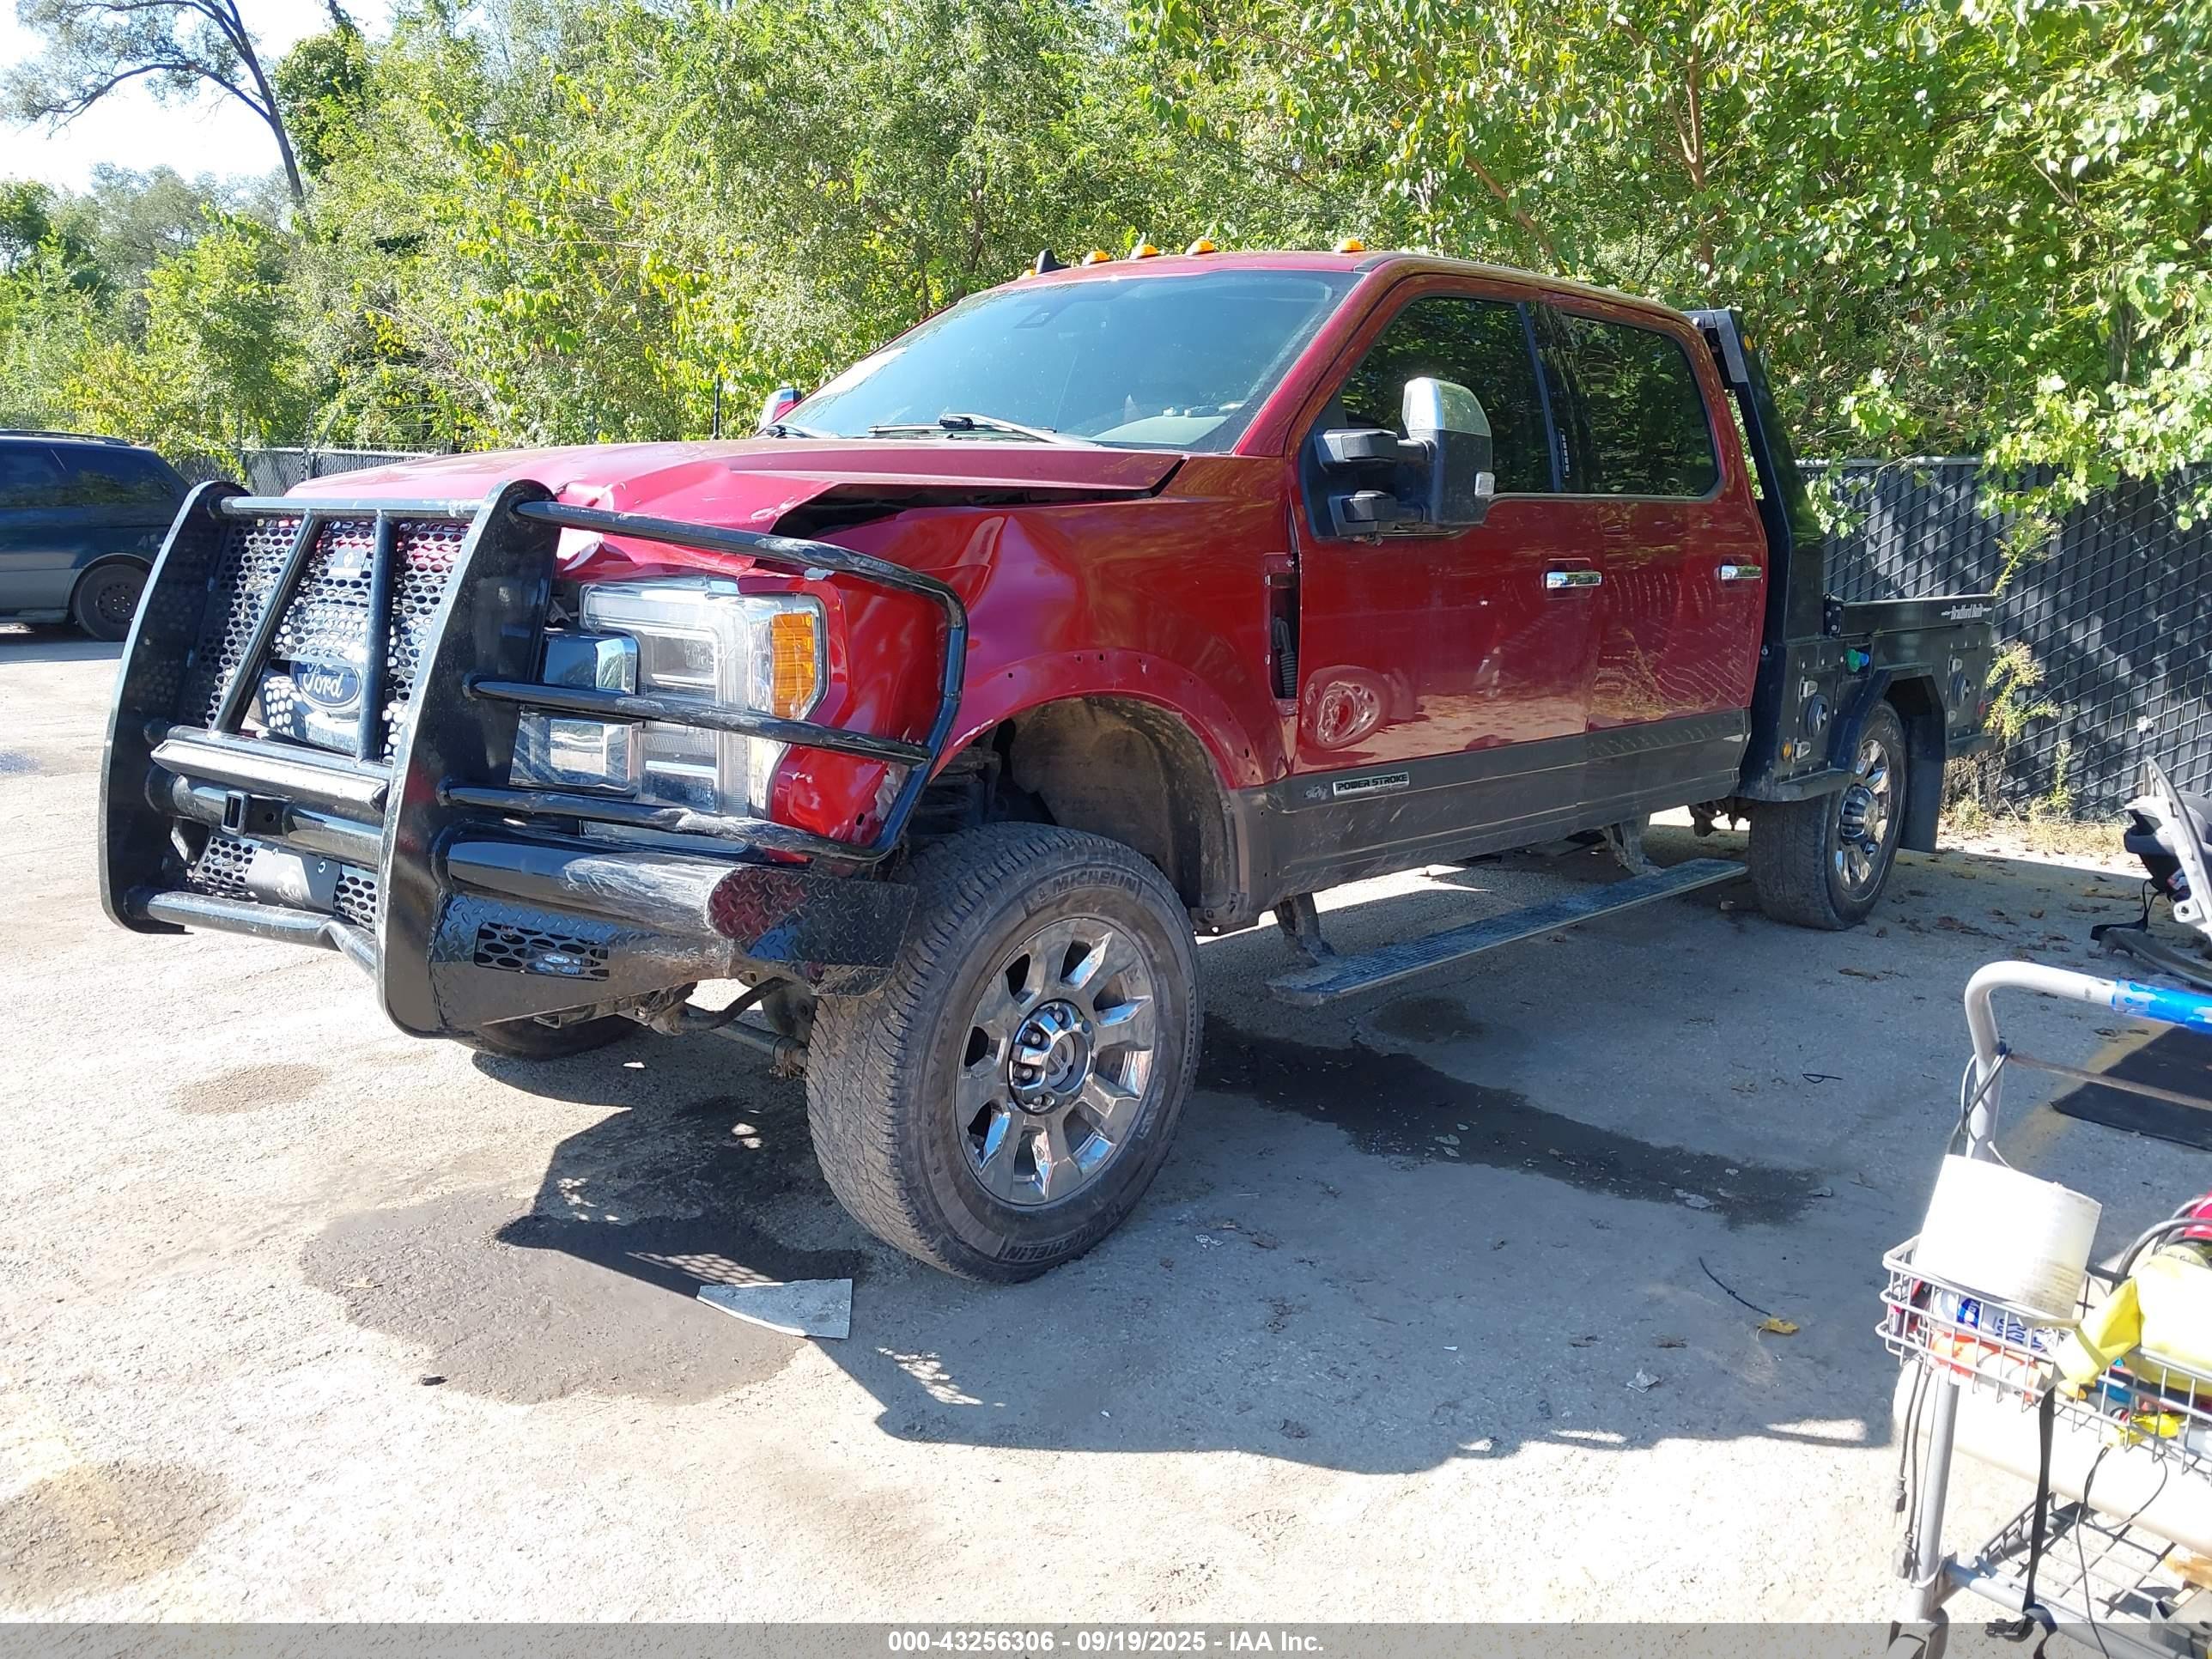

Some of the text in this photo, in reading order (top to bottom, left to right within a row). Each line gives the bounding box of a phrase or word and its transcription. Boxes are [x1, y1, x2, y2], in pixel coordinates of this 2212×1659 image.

[303, 661, 344, 698] Ford
[1337, 781, 1370, 791] POWER
[1371, 774, 1407, 785] STROKE
[1053, 869, 1135, 893] MICHELIN
[1003, 1225, 1097, 1261] MICHELIN
